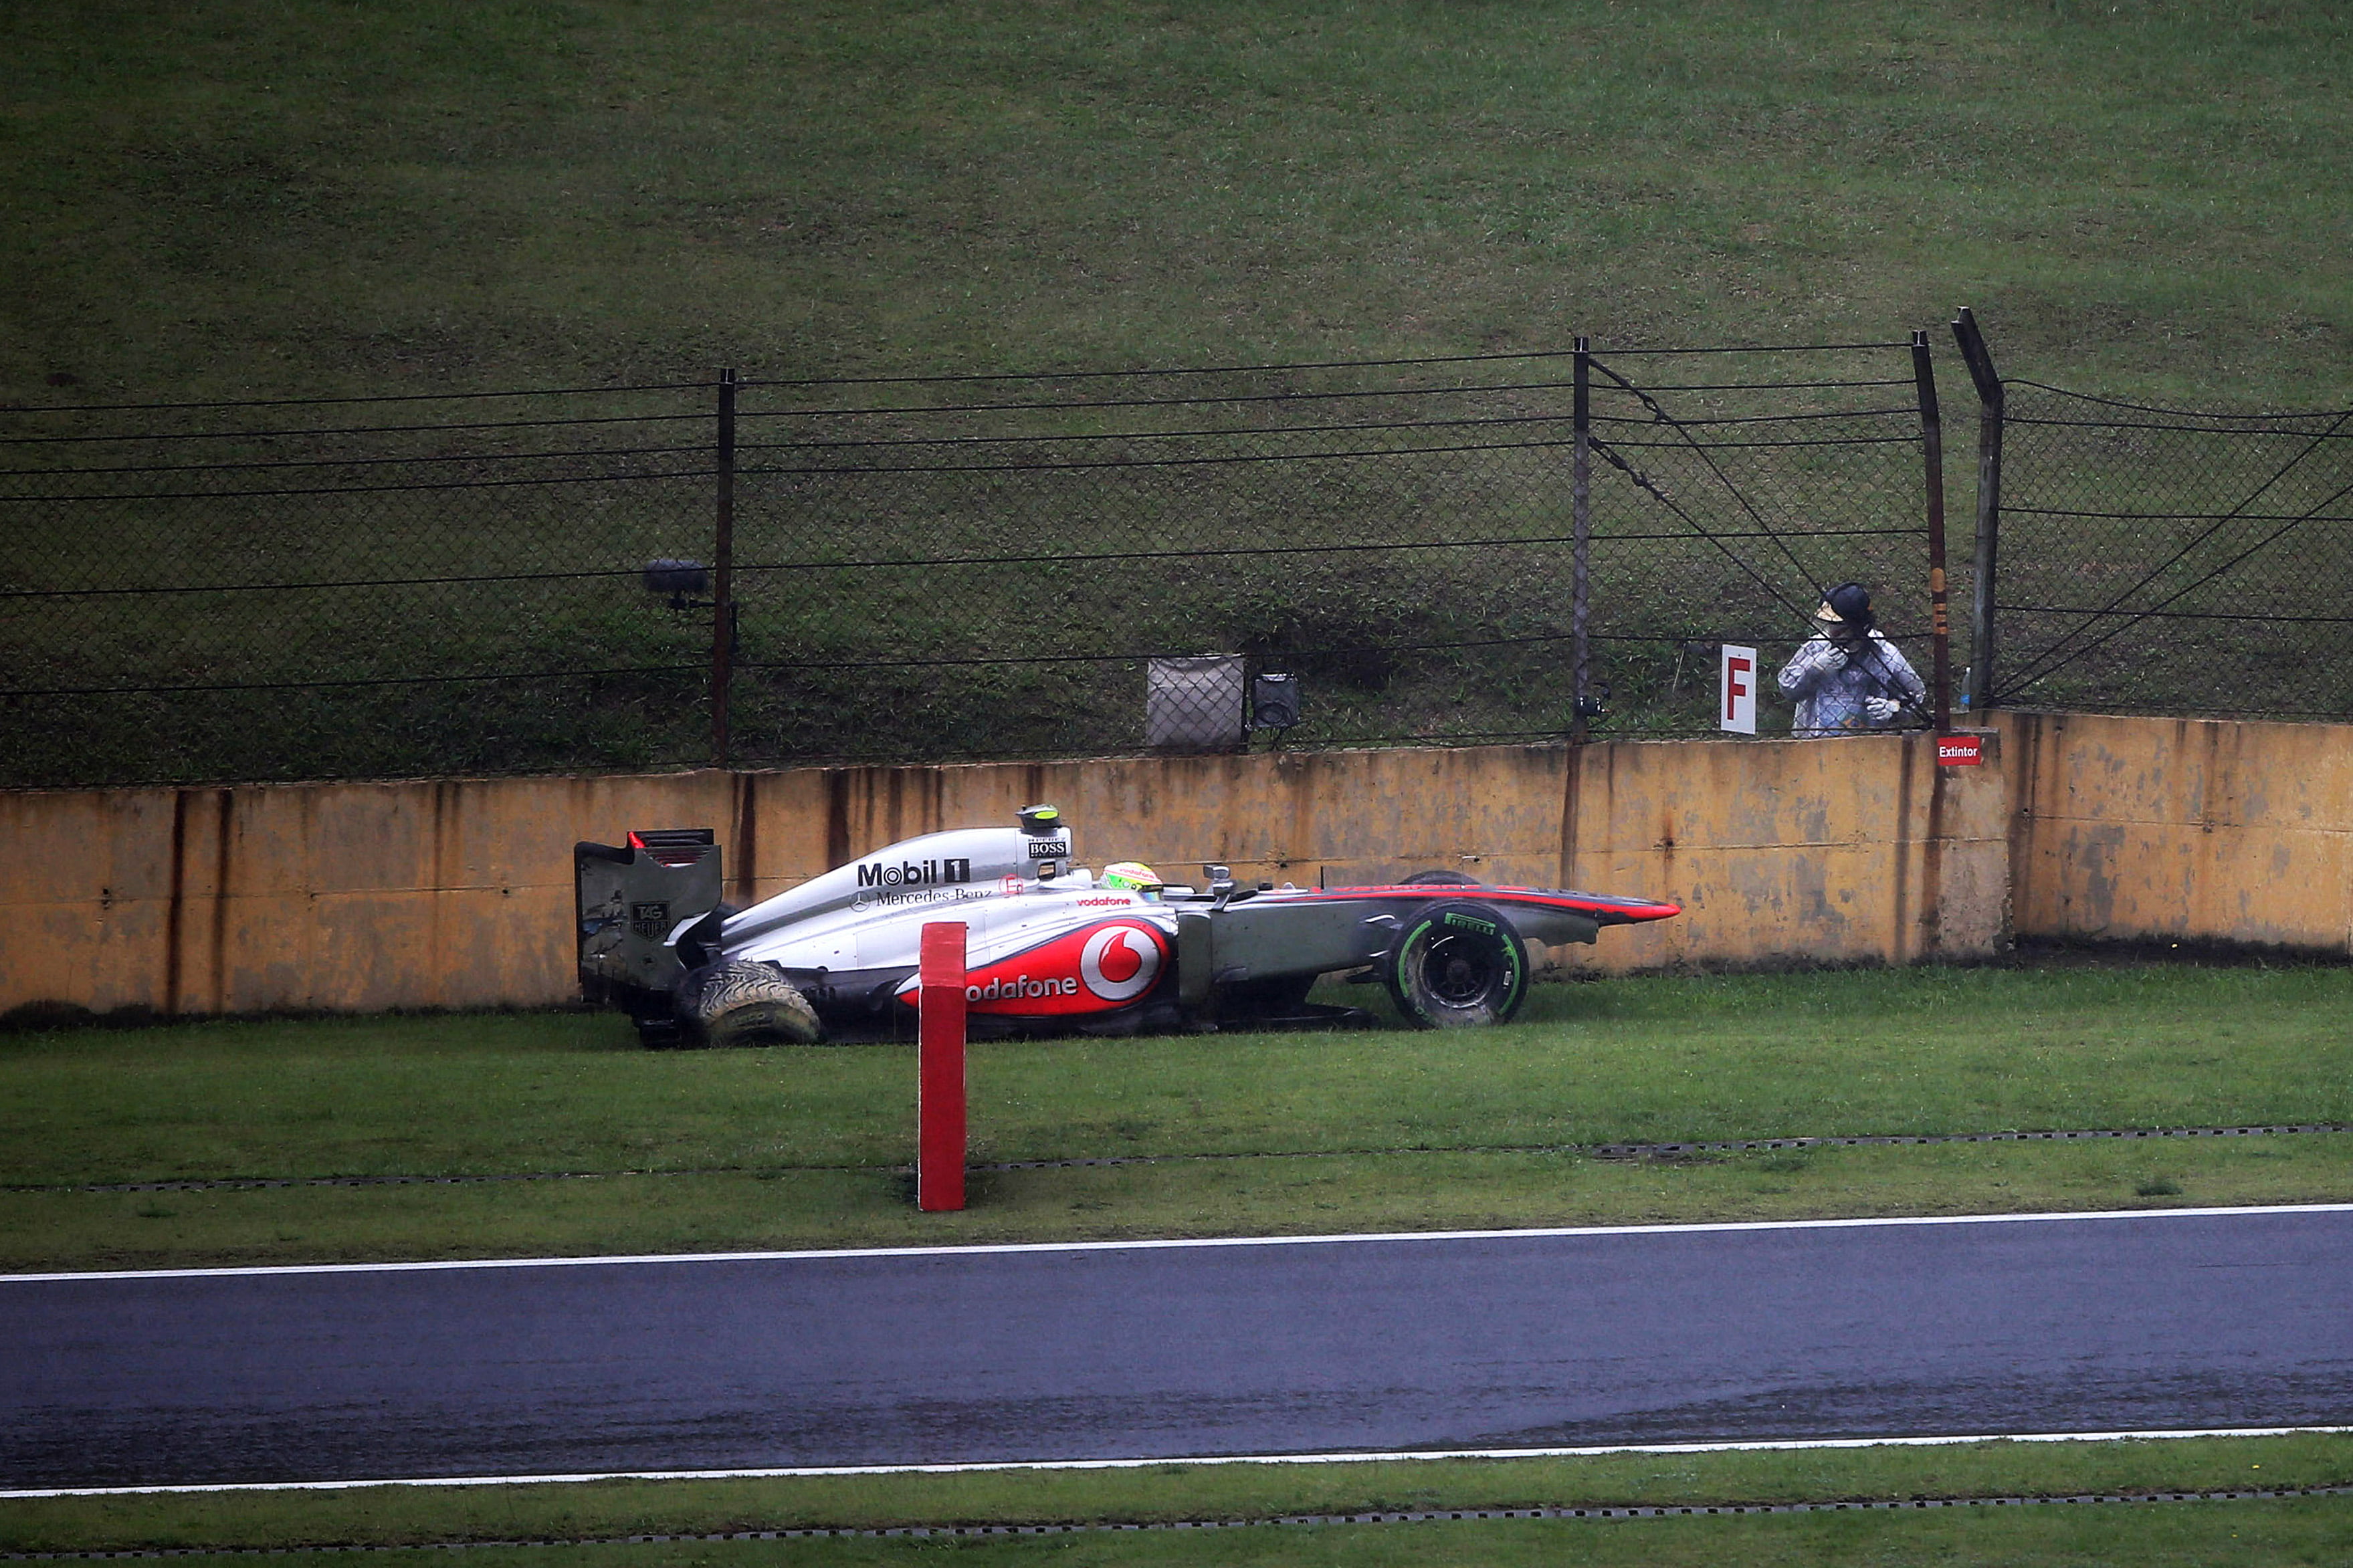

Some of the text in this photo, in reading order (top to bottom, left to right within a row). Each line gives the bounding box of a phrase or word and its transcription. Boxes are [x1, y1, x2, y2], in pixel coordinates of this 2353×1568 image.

[1728, 657, 1750, 720] F
[1940, 746, 1978, 758] Extintor
[1031, 843, 1065, 854] BOSS
[858, 860, 936, 887] Mobil
[877, 888, 992, 906] Mercedes-Benz
[1076, 897, 1131, 906] vodafone
[637, 905, 662, 919] TAG
[965, 974, 1078, 1002] odafone
